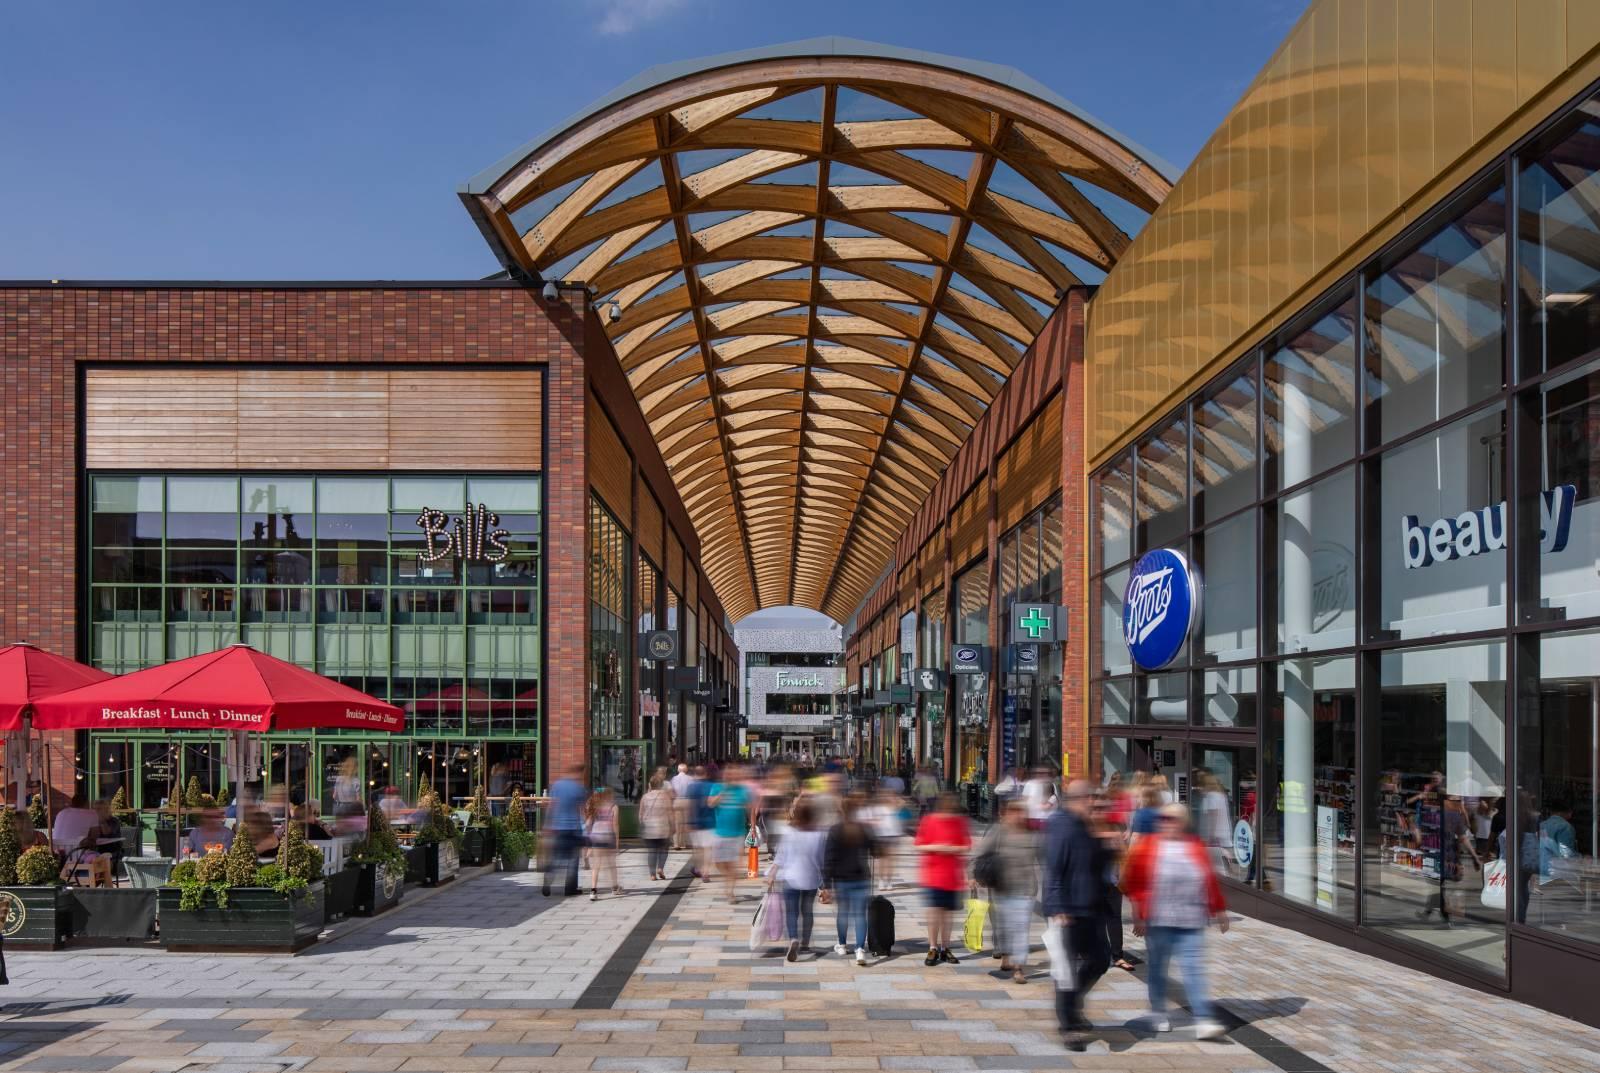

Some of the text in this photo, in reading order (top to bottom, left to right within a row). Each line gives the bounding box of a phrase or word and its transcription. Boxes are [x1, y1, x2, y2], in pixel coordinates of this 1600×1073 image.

[415, 502, 512, 563] Bill's
[1401, 485, 1576, 569] beauy
[1126, 565, 1175, 646] Boots
[954, 664, 980, 672] Opticians
[776, 671, 824, 690] Fenwick
[102, 707, 263, 723] Breakfast Lunch Dinner
[346, 708, 366, 719] Breakfast
